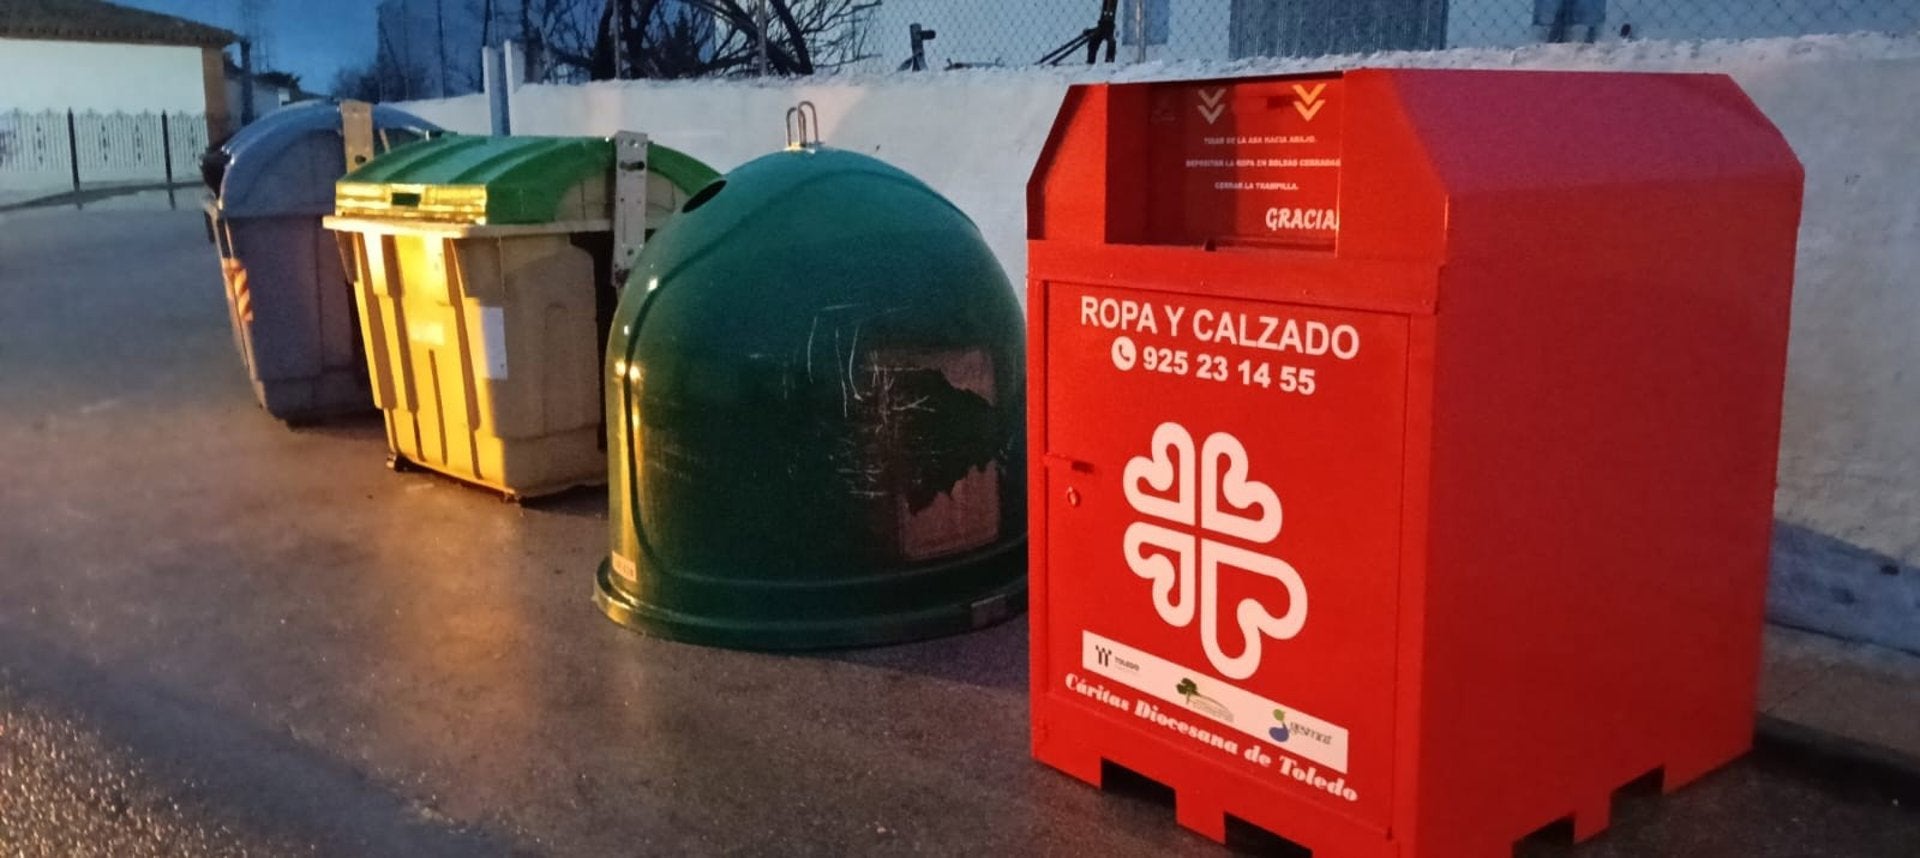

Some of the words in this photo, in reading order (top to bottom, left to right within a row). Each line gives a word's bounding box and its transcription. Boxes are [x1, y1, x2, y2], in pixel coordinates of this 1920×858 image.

[1265, 207, 1339, 231] GRACIA
[1080, 295, 1157, 335] ROPA
[1164, 305, 1185, 337] Y
[1192, 309, 1360, 360] CALZADO
[1142, 346, 1189, 376] 925
[1196, 354, 1228, 382] 23
[1237, 360, 1271, 388] 14
[1279, 366, 1316, 396] 55
[1065, 673, 1130, 712] Cáritas
[1133, 699, 1238, 755] Diocesana
[1244, 745, 1272, 768] de
[1279, 754, 1358, 802] Toledo
